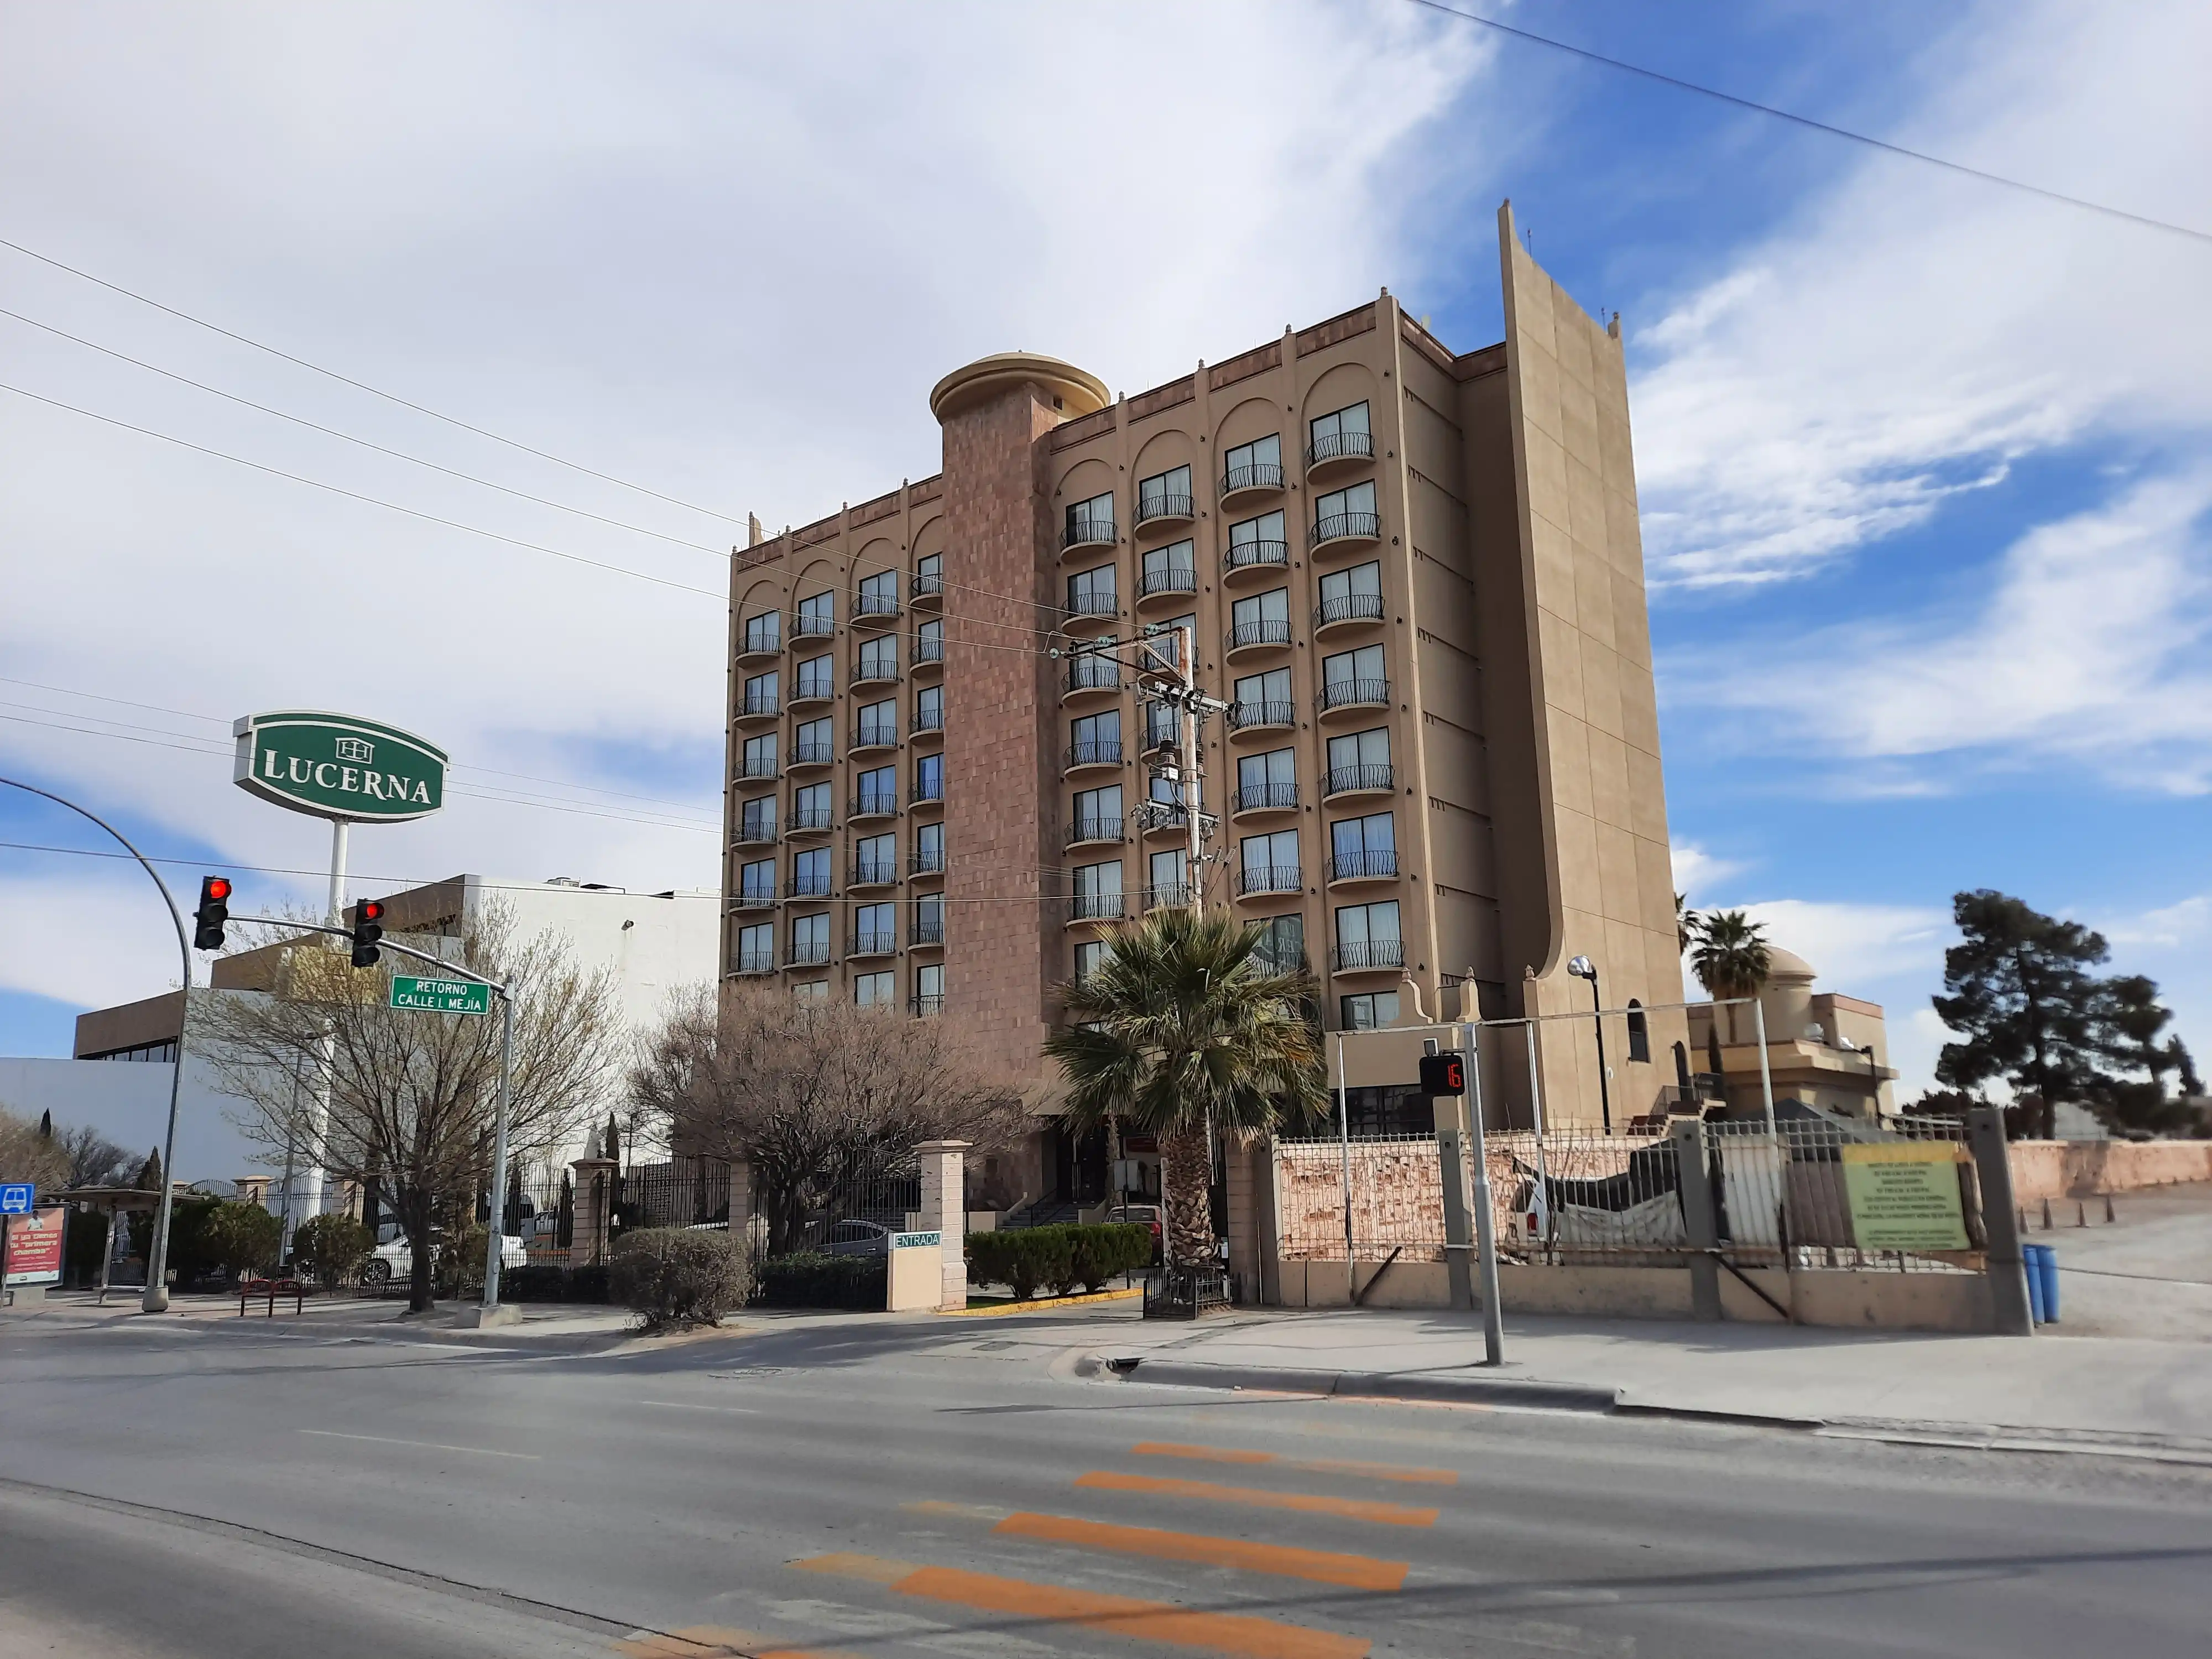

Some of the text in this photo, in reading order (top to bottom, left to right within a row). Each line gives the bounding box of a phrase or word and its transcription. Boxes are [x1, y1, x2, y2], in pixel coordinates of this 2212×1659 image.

[264, 749, 432, 805] LUCERNA
[416, 981, 467, 995] RETORNO
[398, 994, 435, 1008] CALLE
[448, 997, 481, 1011] MEJÍA
[896, 1234, 939, 1247] ENTRADA
